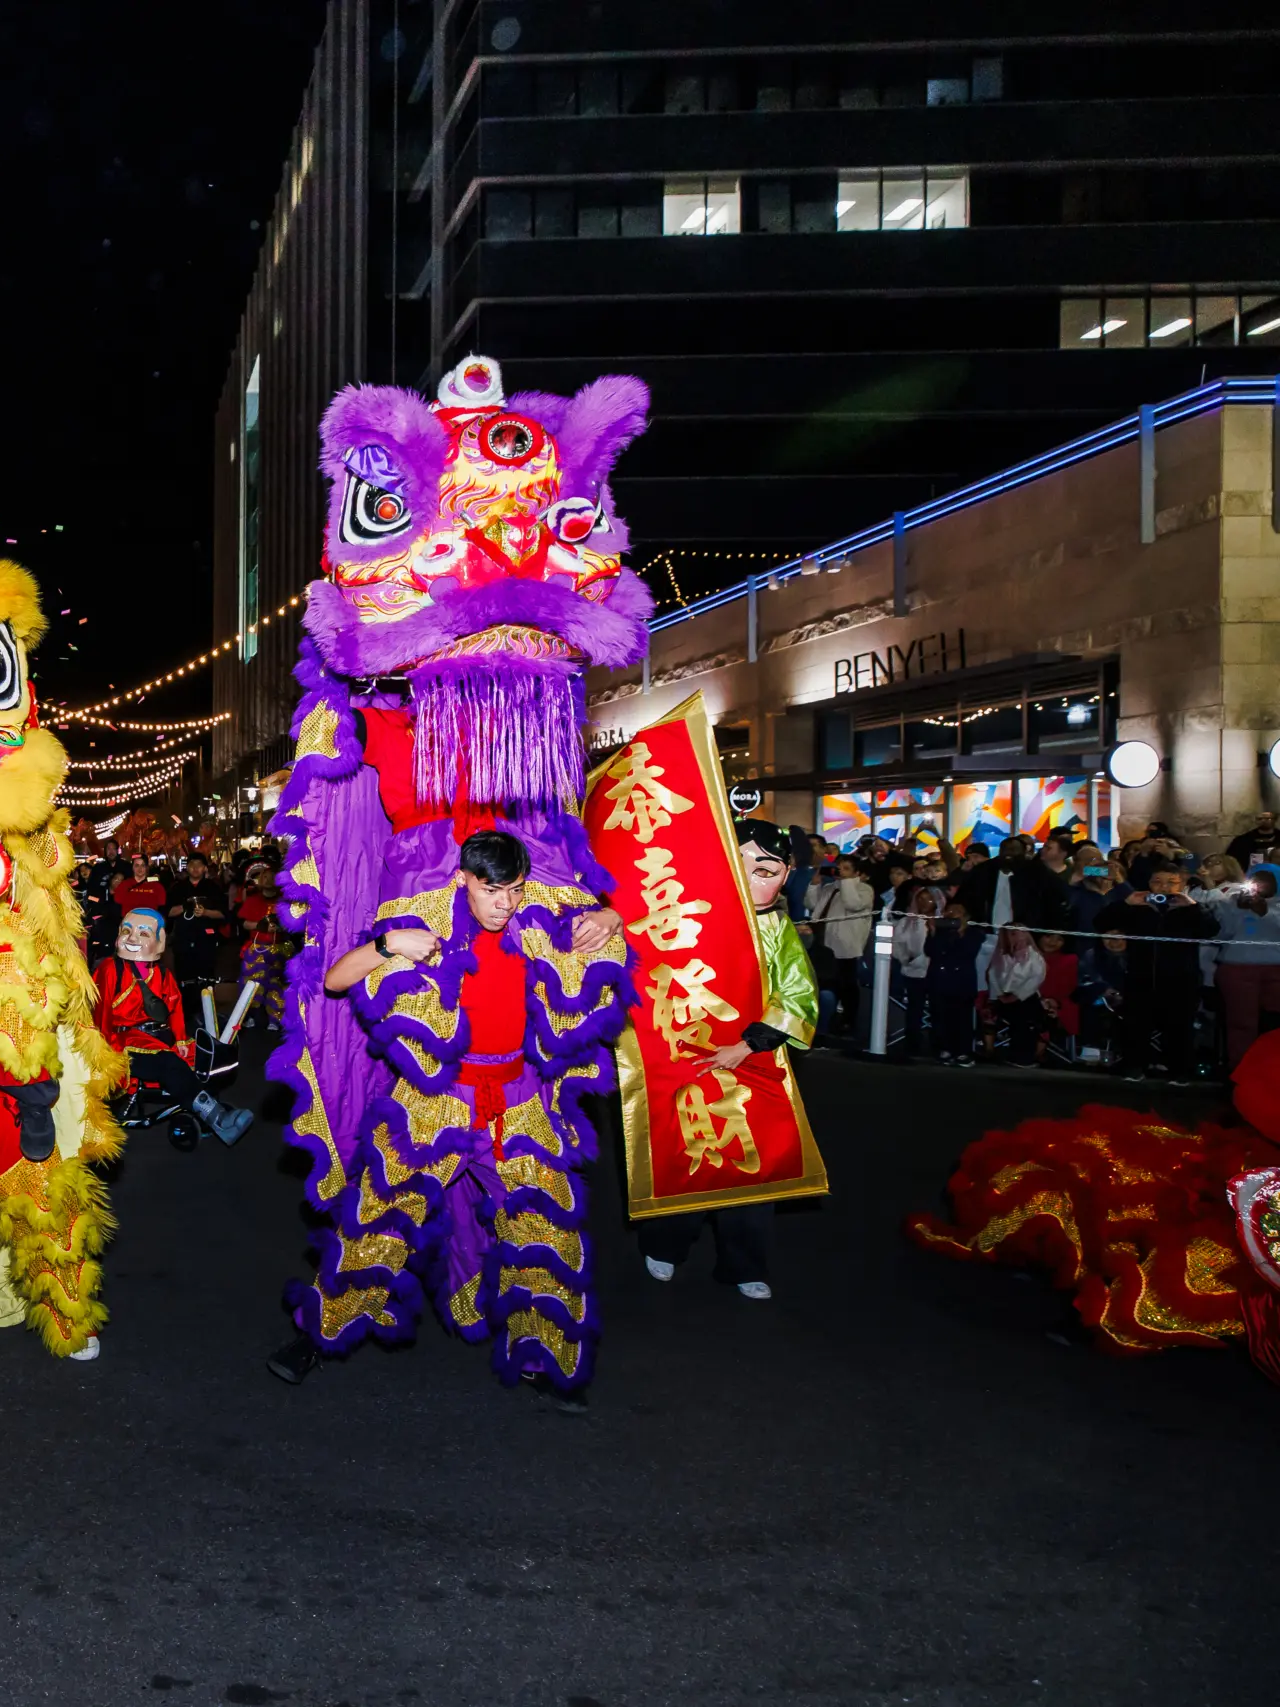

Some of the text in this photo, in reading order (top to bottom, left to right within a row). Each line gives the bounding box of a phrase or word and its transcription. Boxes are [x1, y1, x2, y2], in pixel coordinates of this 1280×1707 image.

[733, 793, 757, 801] MORA
[604, 742, 762, 1176] 恭喜發財
